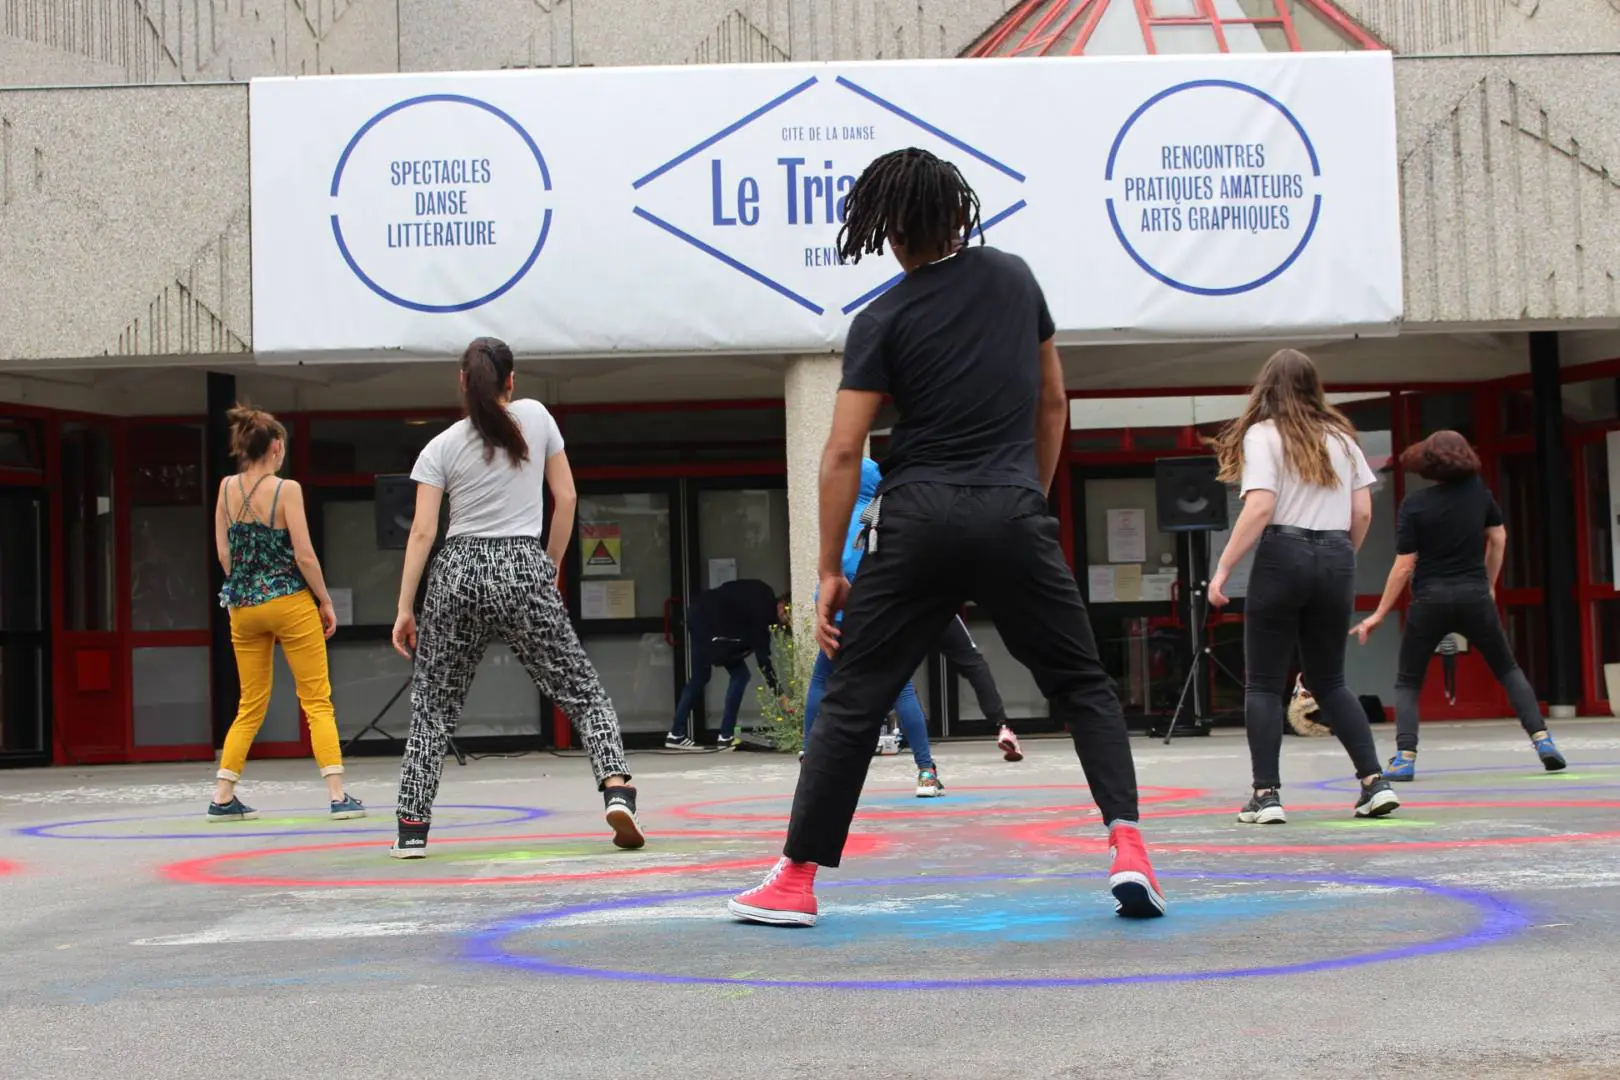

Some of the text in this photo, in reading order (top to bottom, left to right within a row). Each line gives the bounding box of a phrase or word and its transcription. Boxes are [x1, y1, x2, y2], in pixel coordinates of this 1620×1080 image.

[809, 127, 821, 141] DE
[826, 126, 838, 140] LA
[842, 126, 876, 140] DANSE
[1162, 144, 1265, 169] RENCONTRES
[390, 159, 491, 186] SPECTACLES
[416, 190, 468, 216] DANSE
[712, 157, 856, 226] Le Tria
[1125, 174, 1303, 205] PRATIQUES AMATEURS
[1141, 205, 1290, 234] ARTS GRAPHIQUES
[388, 220, 497, 248] LITTÉRATURE
[805, 247, 858, 266] RENN
